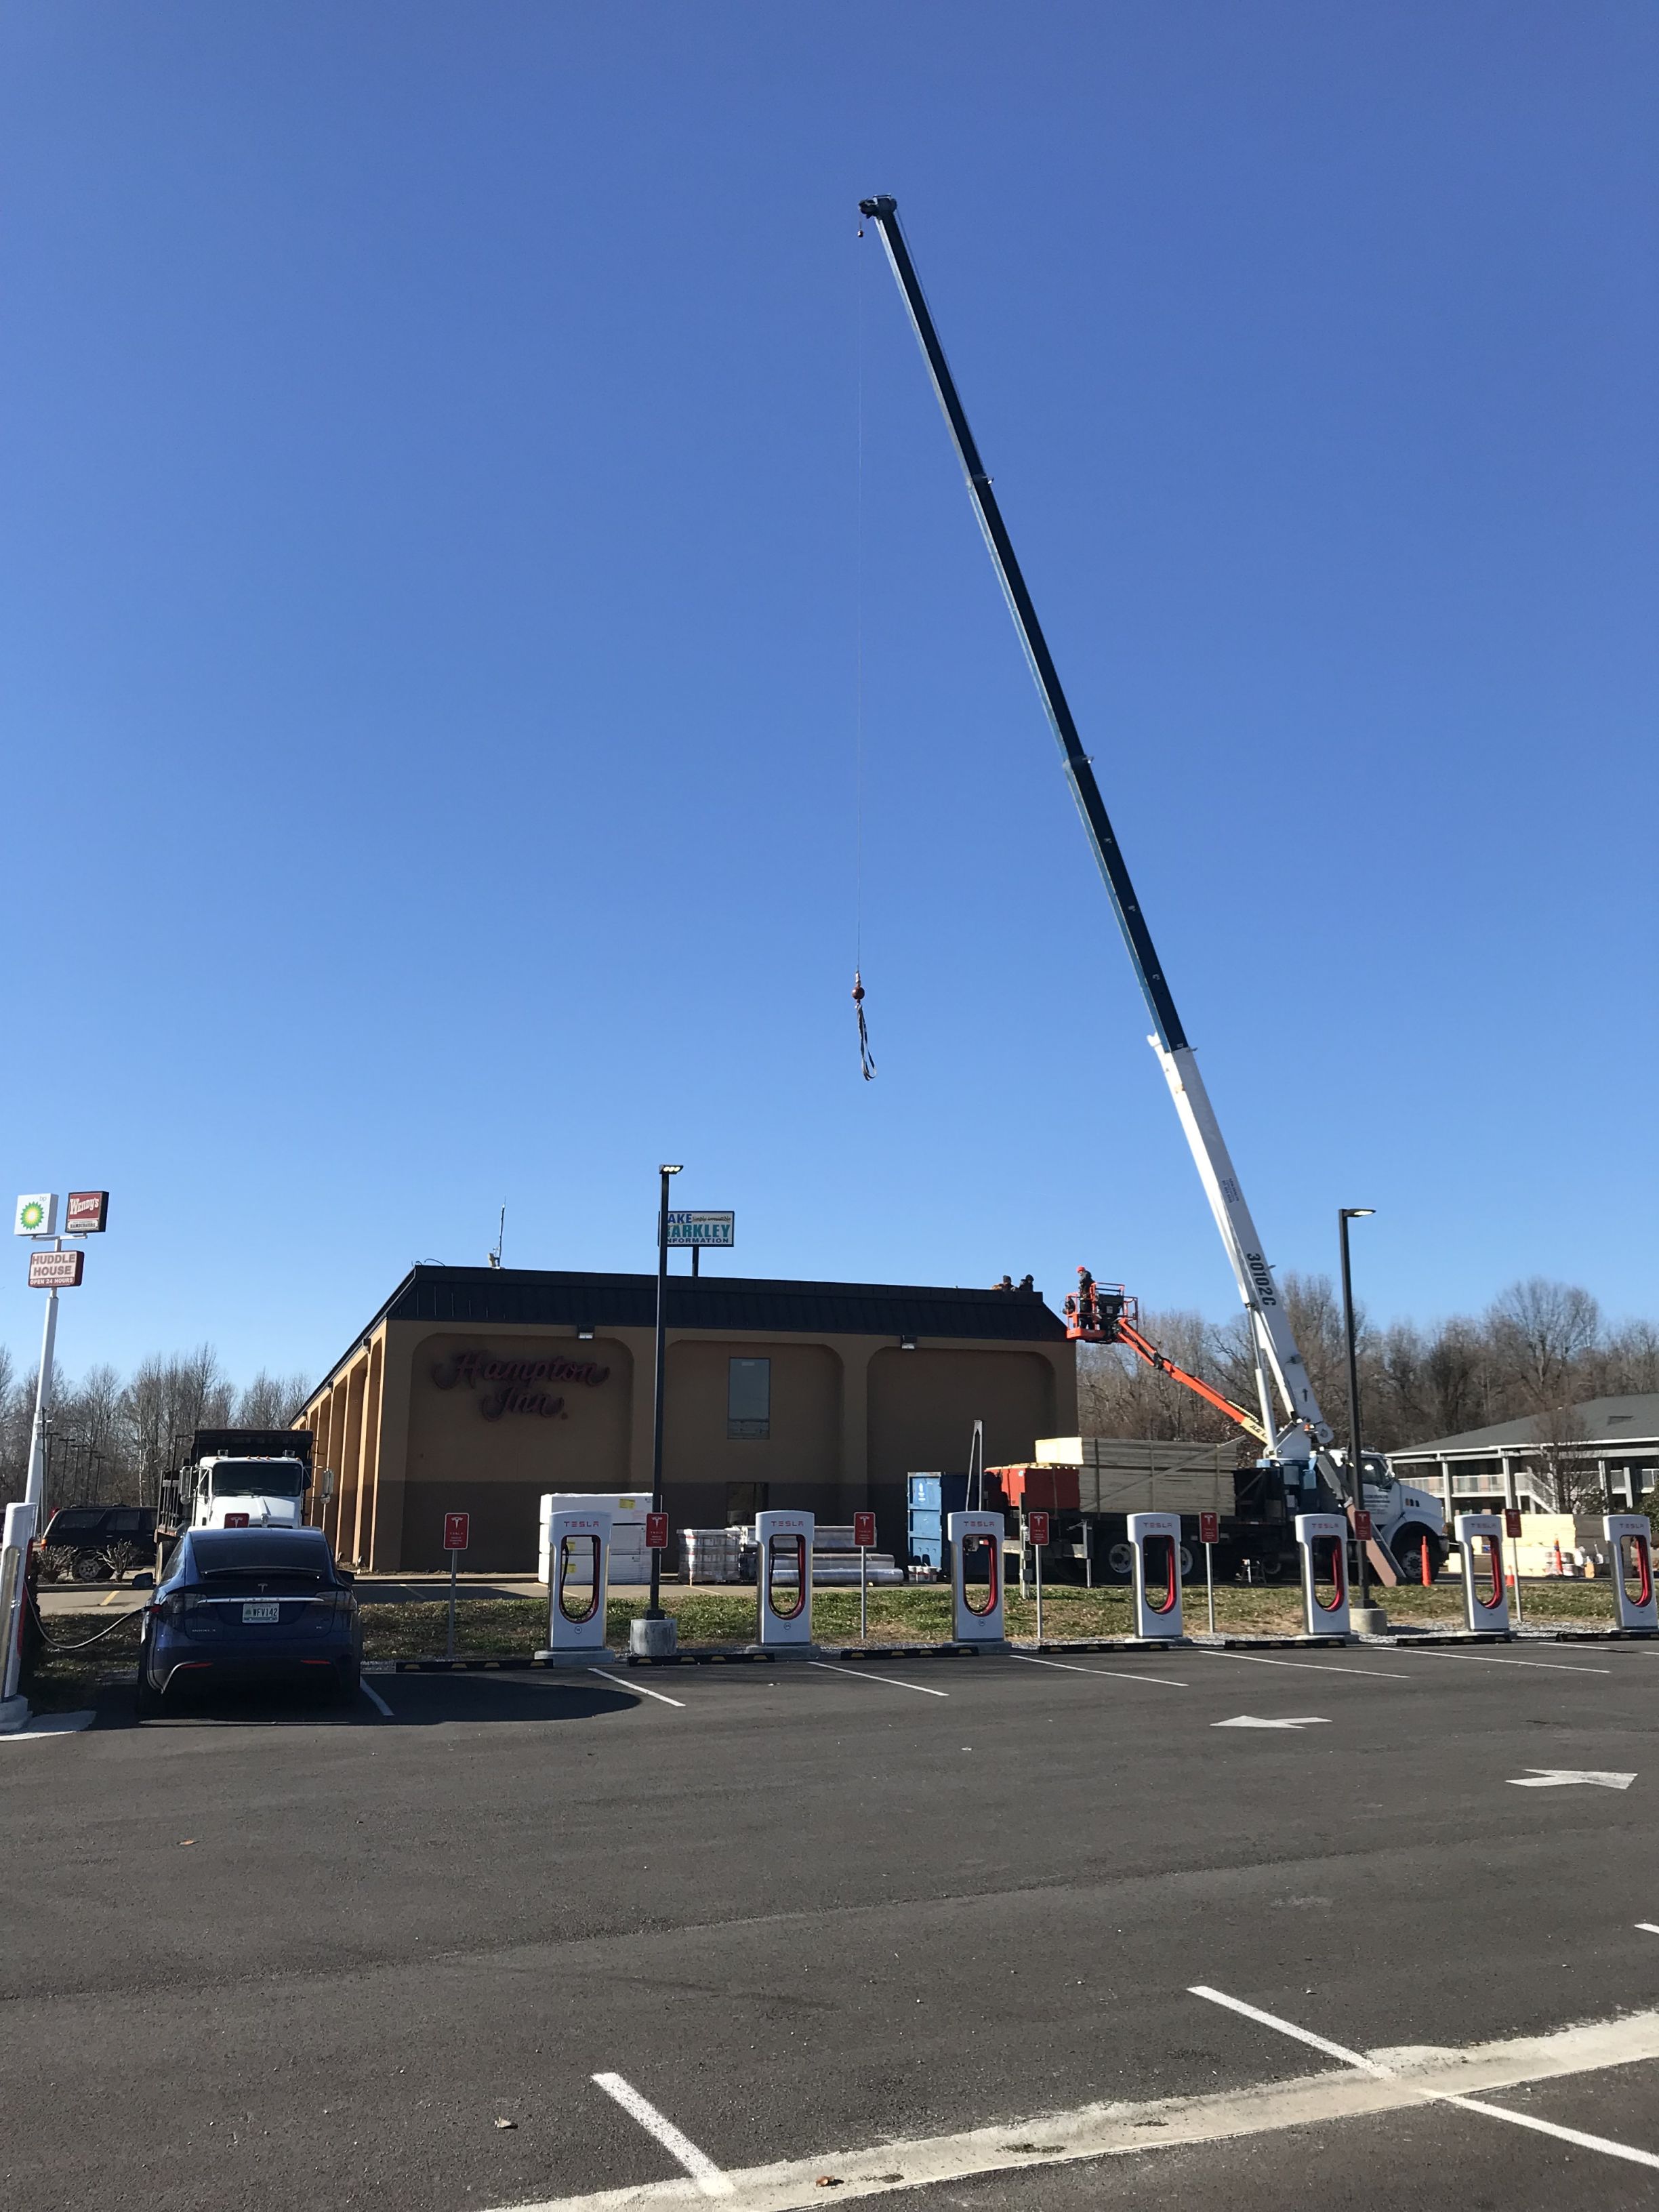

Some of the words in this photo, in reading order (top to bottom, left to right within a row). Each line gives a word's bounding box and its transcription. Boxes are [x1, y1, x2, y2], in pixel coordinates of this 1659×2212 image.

[668, 1214, 692, 1223] AKE
[668, 1224, 731, 1237] ARKLEY
[33, 1254, 76, 1265] HUDDLE
[33, 1265, 72, 1276] HOUSE
[1246, 1253, 1276, 1307] 30102C
[431, 1350, 610, 1389] Hampton
[480, 1387, 565, 1422] Inn
